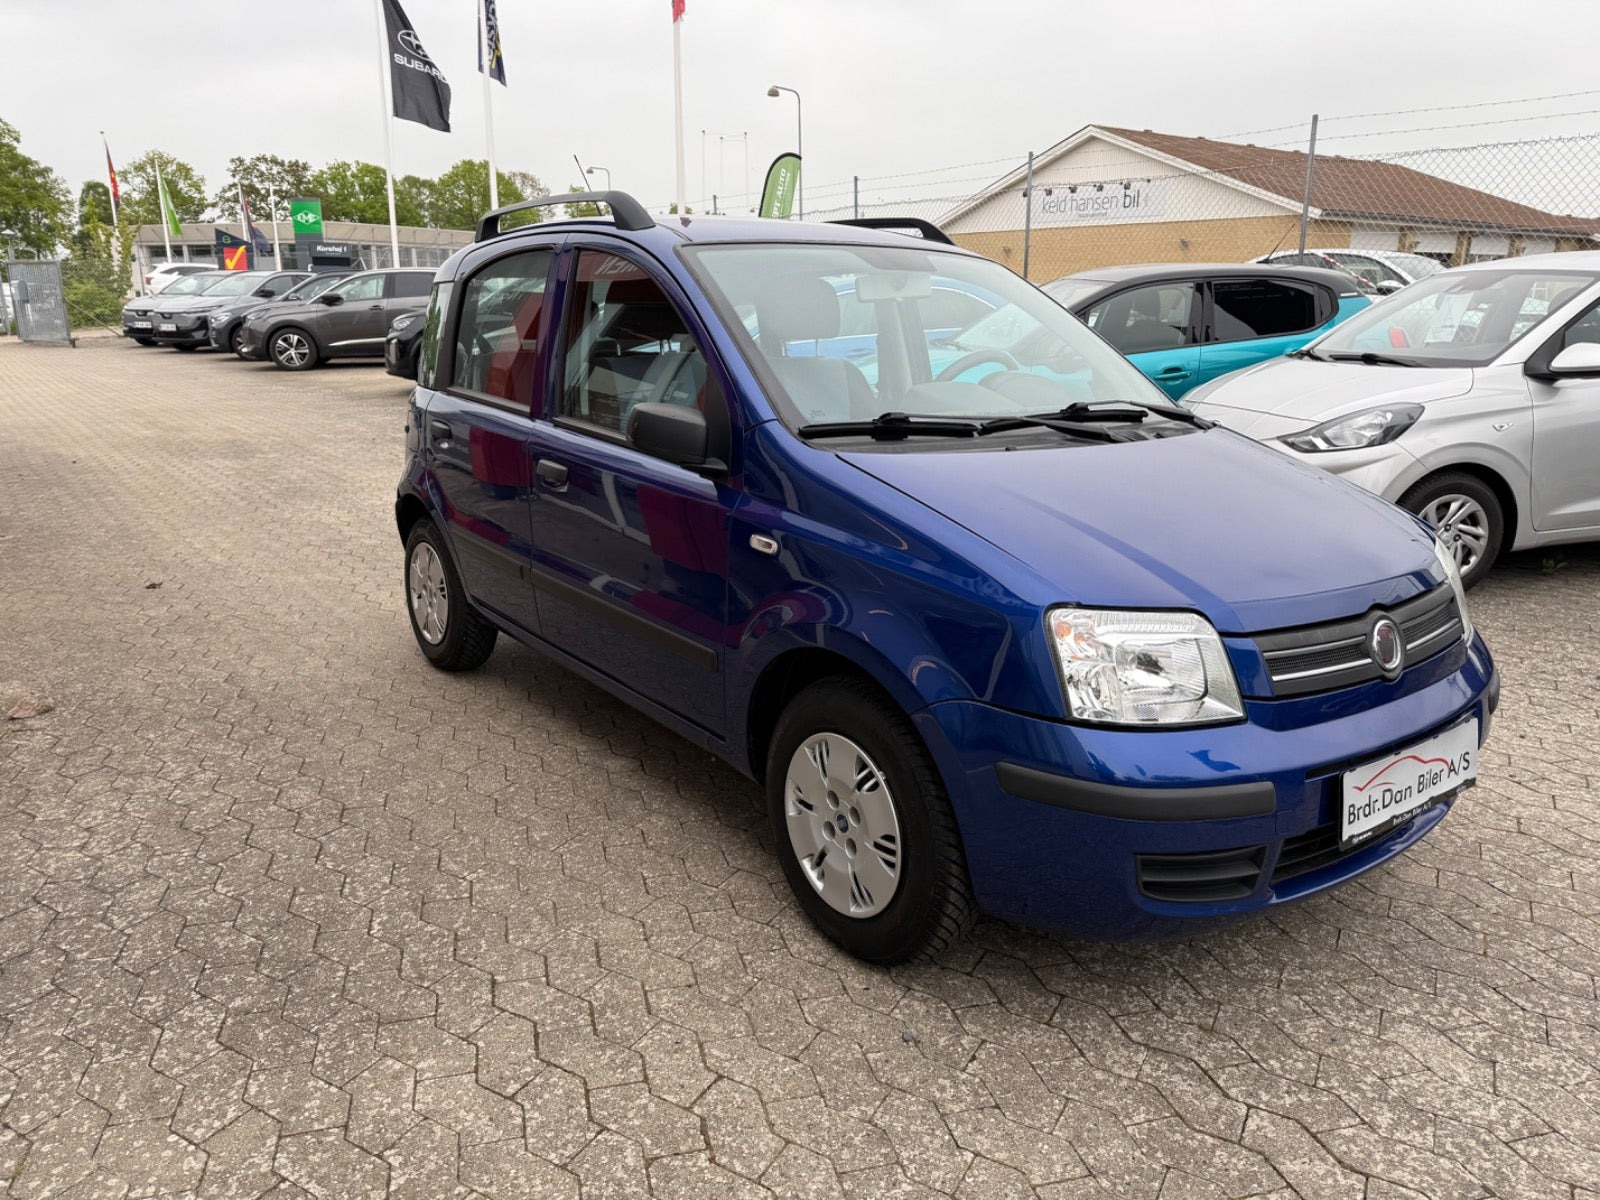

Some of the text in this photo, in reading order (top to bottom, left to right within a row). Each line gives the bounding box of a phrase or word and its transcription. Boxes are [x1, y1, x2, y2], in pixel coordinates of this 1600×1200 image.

[777, 167, 787, 198] AUTO
[1042, 196, 1067, 213] keld
[1070, 194, 1118, 212] hansen
[1123, 188, 1139, 208] bil
[1417, 769, 1444, 793] Biler
[1447, 751, 1470, 778] A/S
